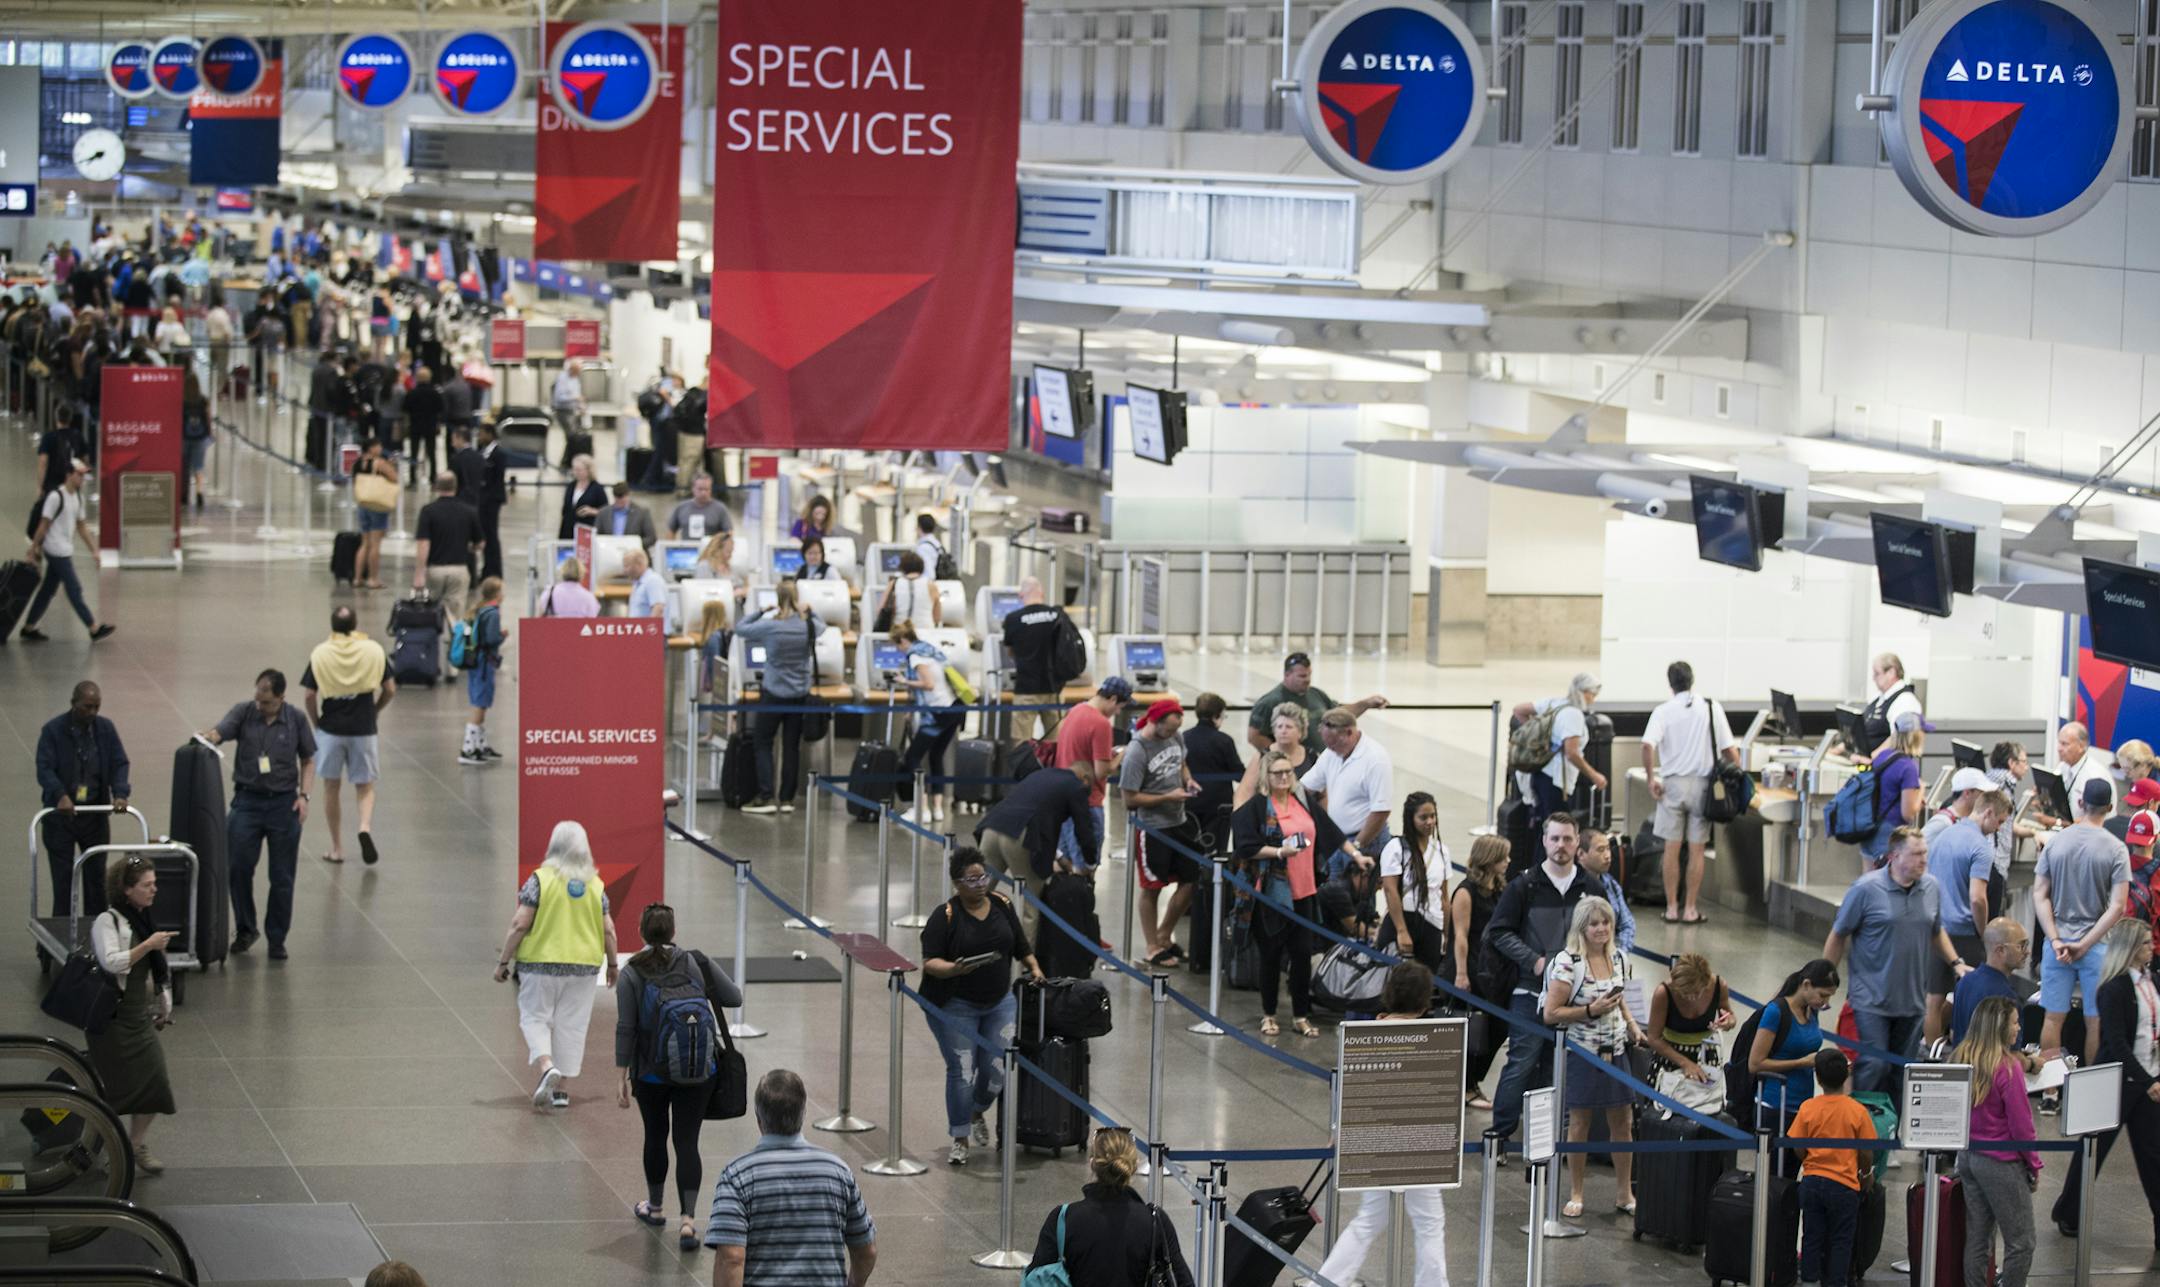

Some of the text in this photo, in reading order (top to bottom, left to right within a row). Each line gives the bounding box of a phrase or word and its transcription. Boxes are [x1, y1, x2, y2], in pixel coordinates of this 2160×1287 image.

[358, 54, 394, 66] DELTA
[464, 54, 498, 67] DELTA
[583, 54, 628, 67] DELTA
[1363, 53, 1435, 72] DELTA
[728, 43, 925, 92] SPECIAL
[1976, 61, 2065, 84] DELTA
[726, 107, 954, 157] SERVICES
[107, 421, 162, 434] BAGGAGE
[107, 435, 138, 446] DROP
[2103, 589, 2146, 609] Special Services
[595, 624, 644, 636] DELTA
[1982, 621, 1993, 641] 40
[525, 728, 657, 745] SPECIAL SERVICES
[525, 755, 638, 766] UNACCOMPANIED MINORS
[525, 766, 580, 776] GATE PASSES
[1344, 1034, 1428, 1045] ADVICE TO PASSENGERS
